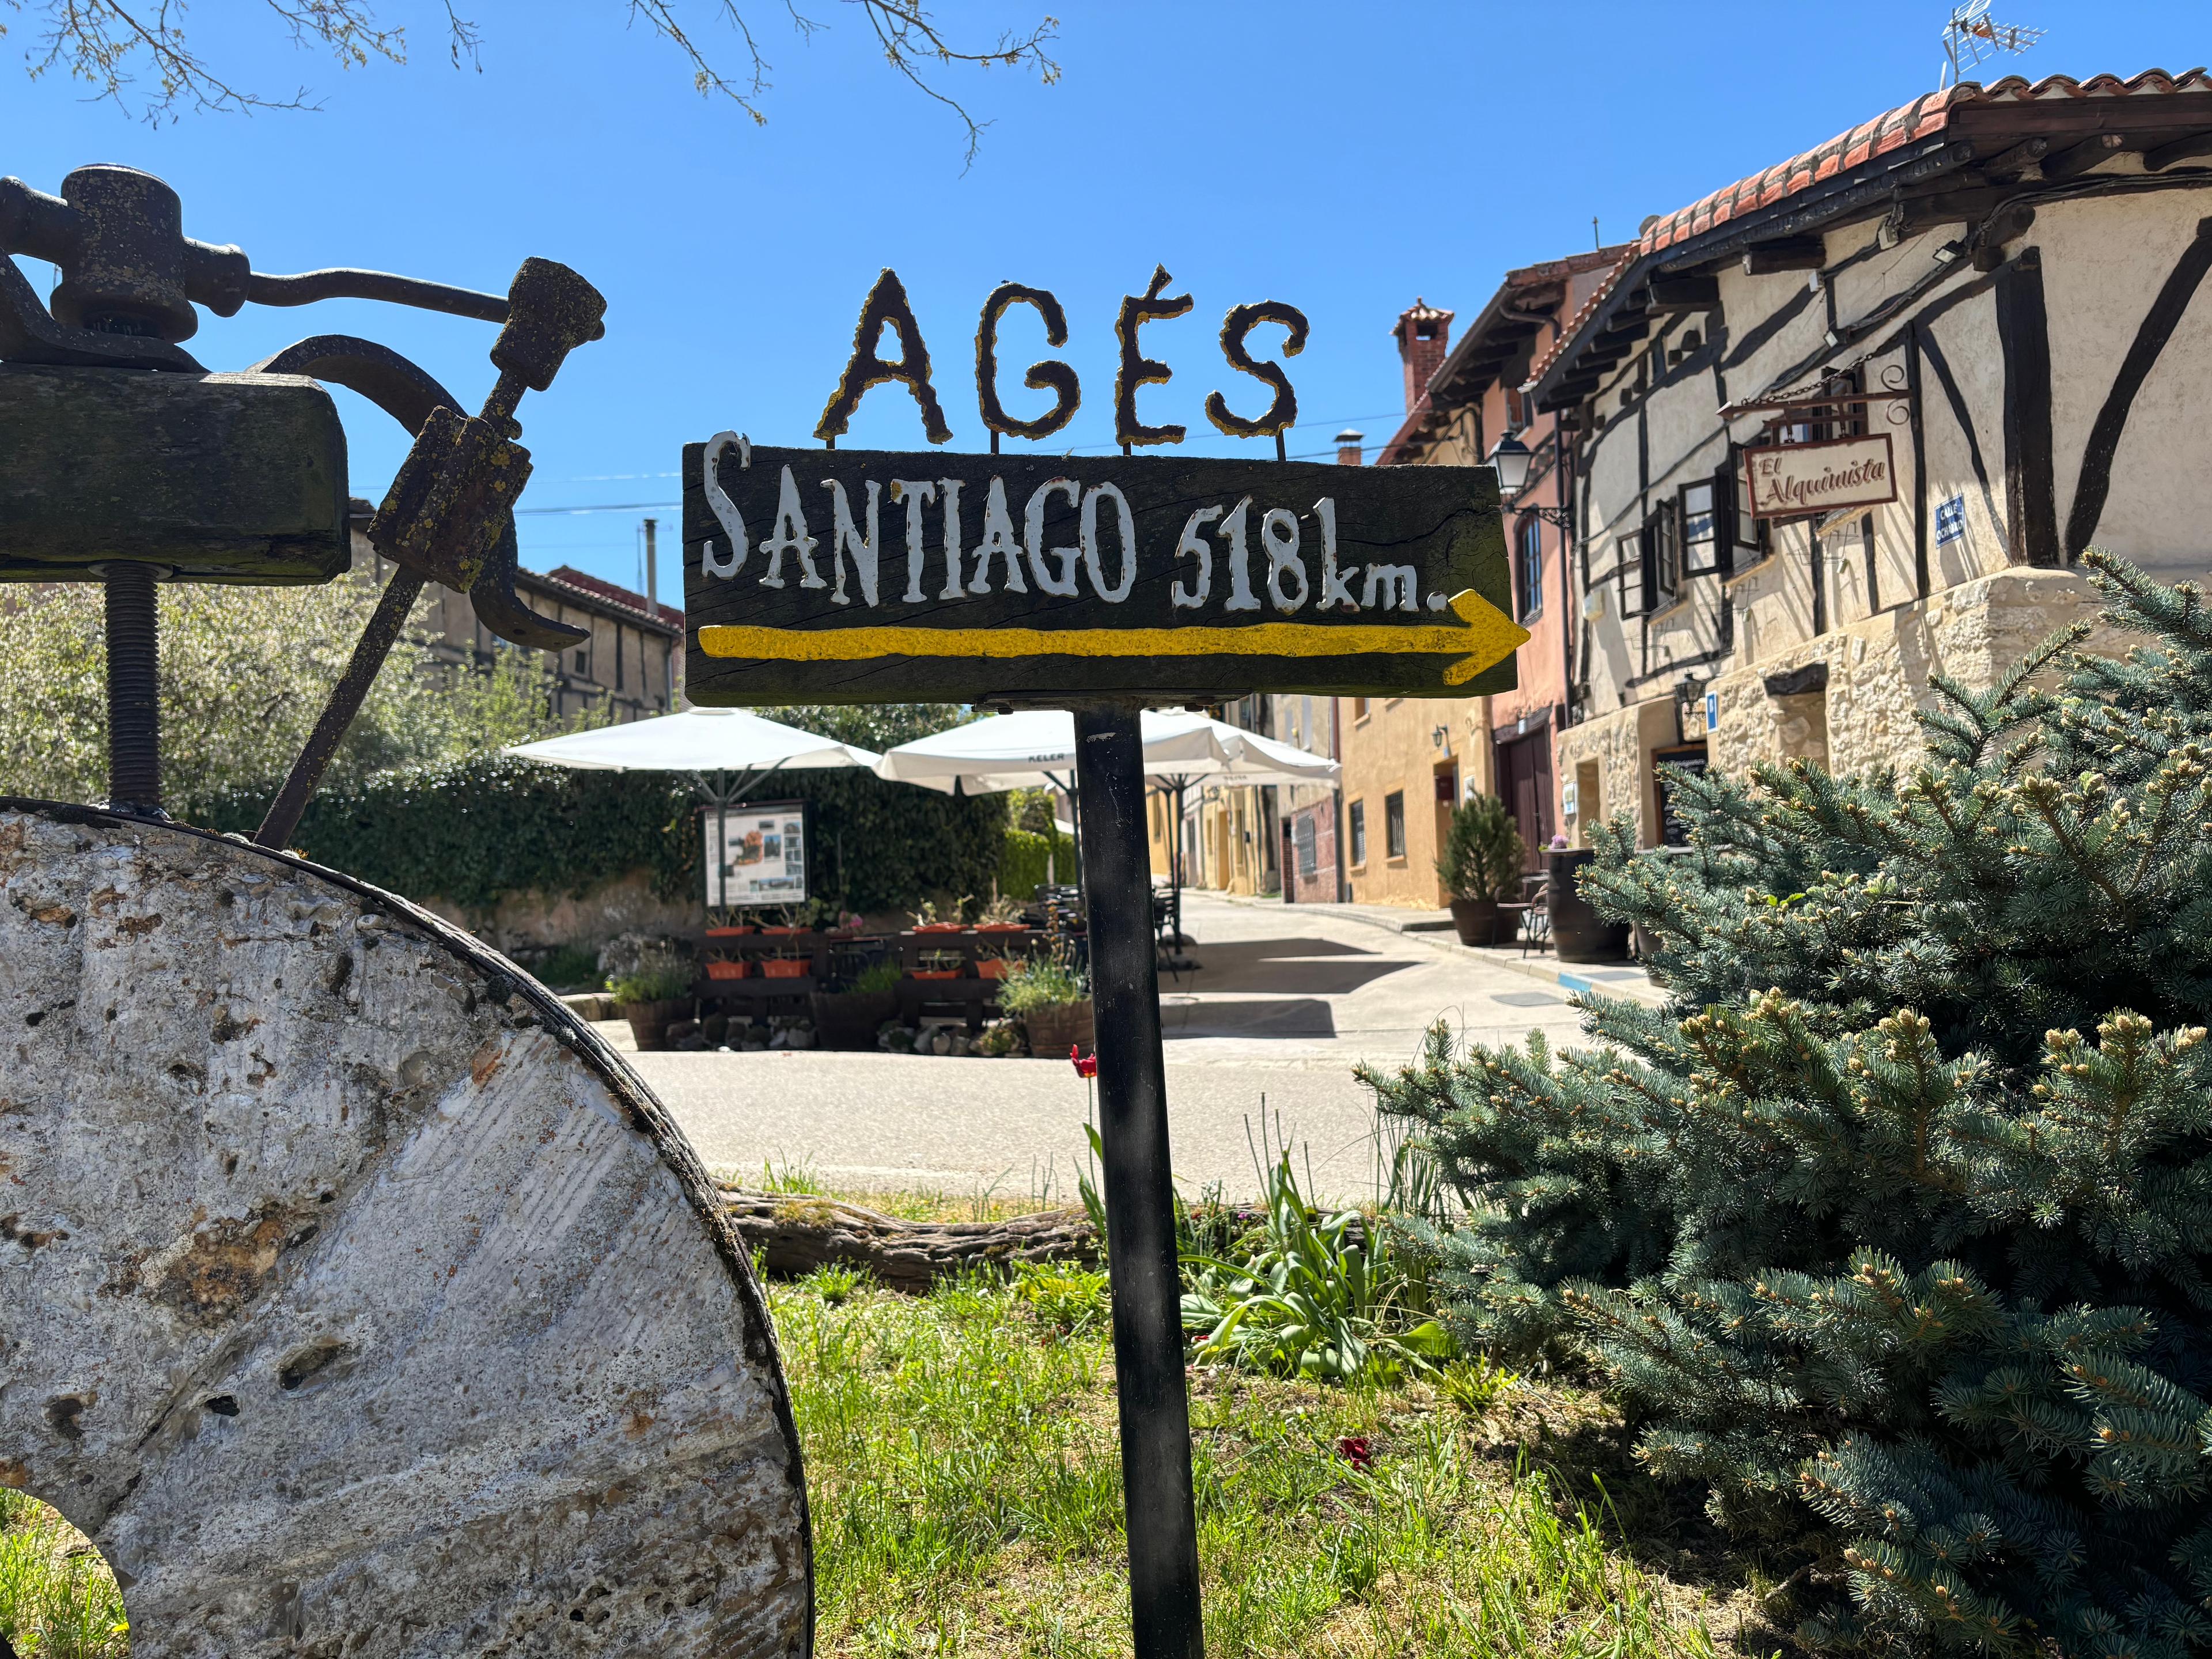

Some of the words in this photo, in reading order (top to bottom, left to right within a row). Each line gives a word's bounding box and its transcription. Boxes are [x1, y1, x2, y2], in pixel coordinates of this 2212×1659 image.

[813, 263, 1310, 445] AGÉS
[1758, 459, 1885, 507] Alquimista
[1760, 457, 1782, 476] El
[702, 430, 1138, 608] SANTIAGO
[1940, 502, 1959, 521] CALLE
